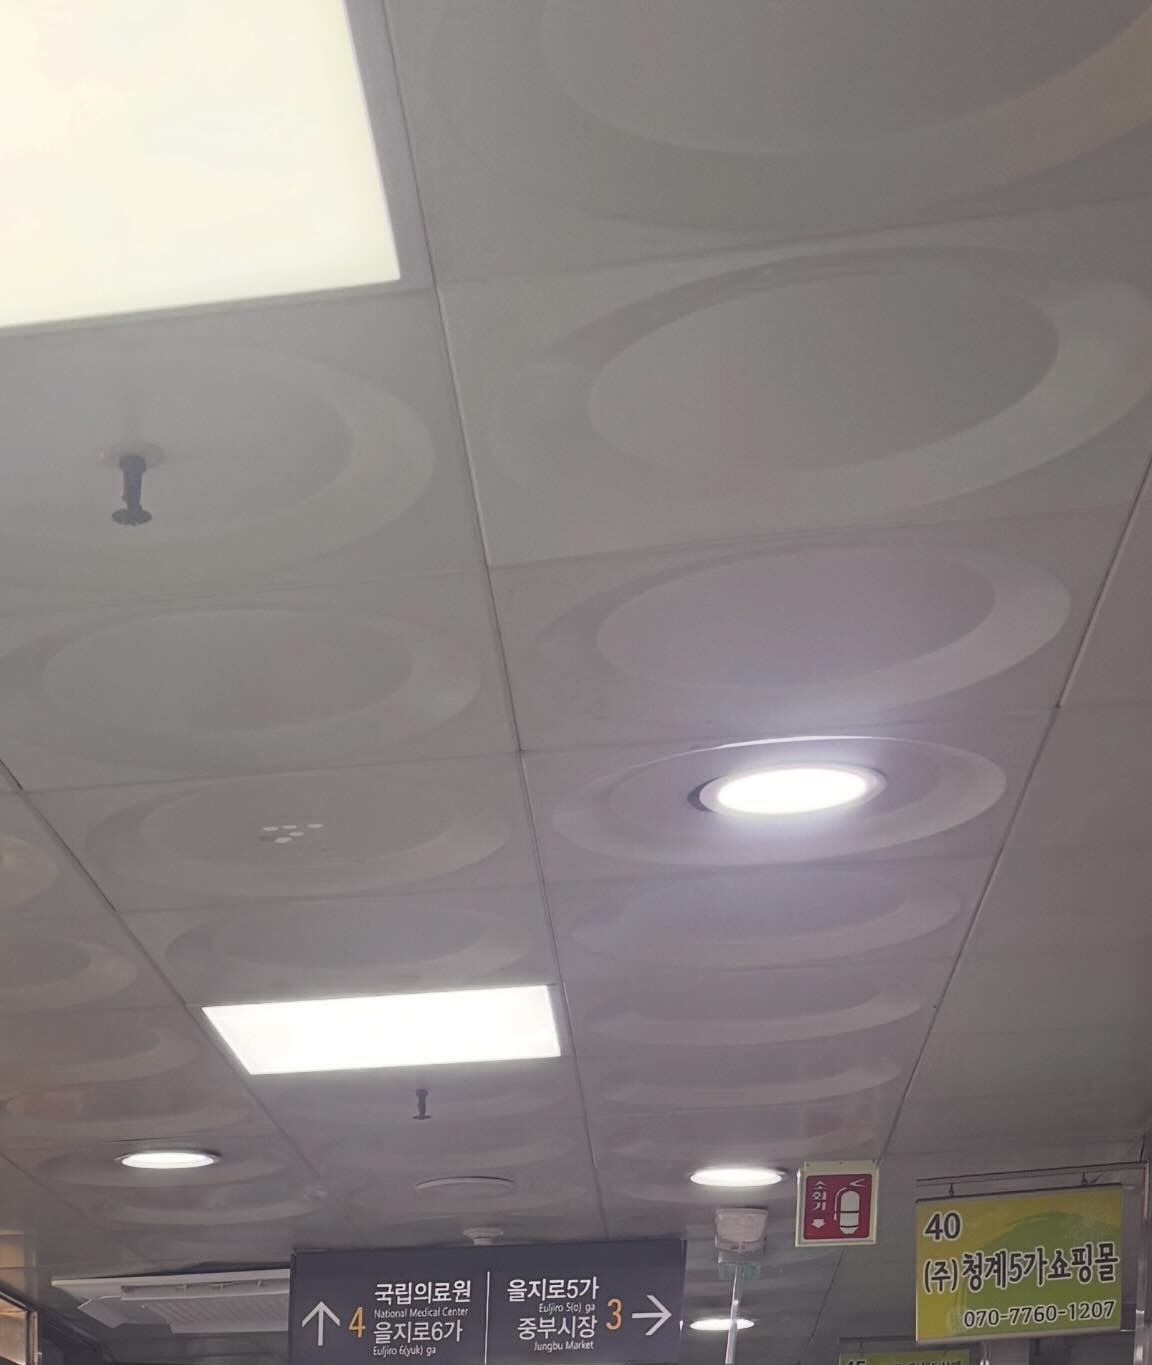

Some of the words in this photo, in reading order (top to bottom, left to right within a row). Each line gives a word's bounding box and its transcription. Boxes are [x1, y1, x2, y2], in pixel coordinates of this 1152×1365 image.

[811, 1181, 827, 1211] 소화기
[924, 1213, 961, 1241] 40
[374, 1280, 471, 1305] 국립의료원
[507, 1276, 599, 1301] 을지로5가
[374, 1309, 407, 1319] National
[409, 1308, 440, 1318] Medical
[442, 1307, 468, 1317] Center
[539, 1303, 564, 1314] Euljiro
[585, 1303, 595, 1313] ga
[606, 1298, 622, 1330] 3
[963, 1301, 1116, 1328] 070-7760-1207
[348, 1306, 366, 1338] 4
[373, 1319, 463, 1344] 을지로6가
[517, 1315, 598, 1340] 중부시장
[373, 1346, 398, 1358] Euljiro
[426, 1346, 437, 1356] ga
[534, 1342, 563, 1353] Jungbu
[565, 1340, 594, 1350] Market
